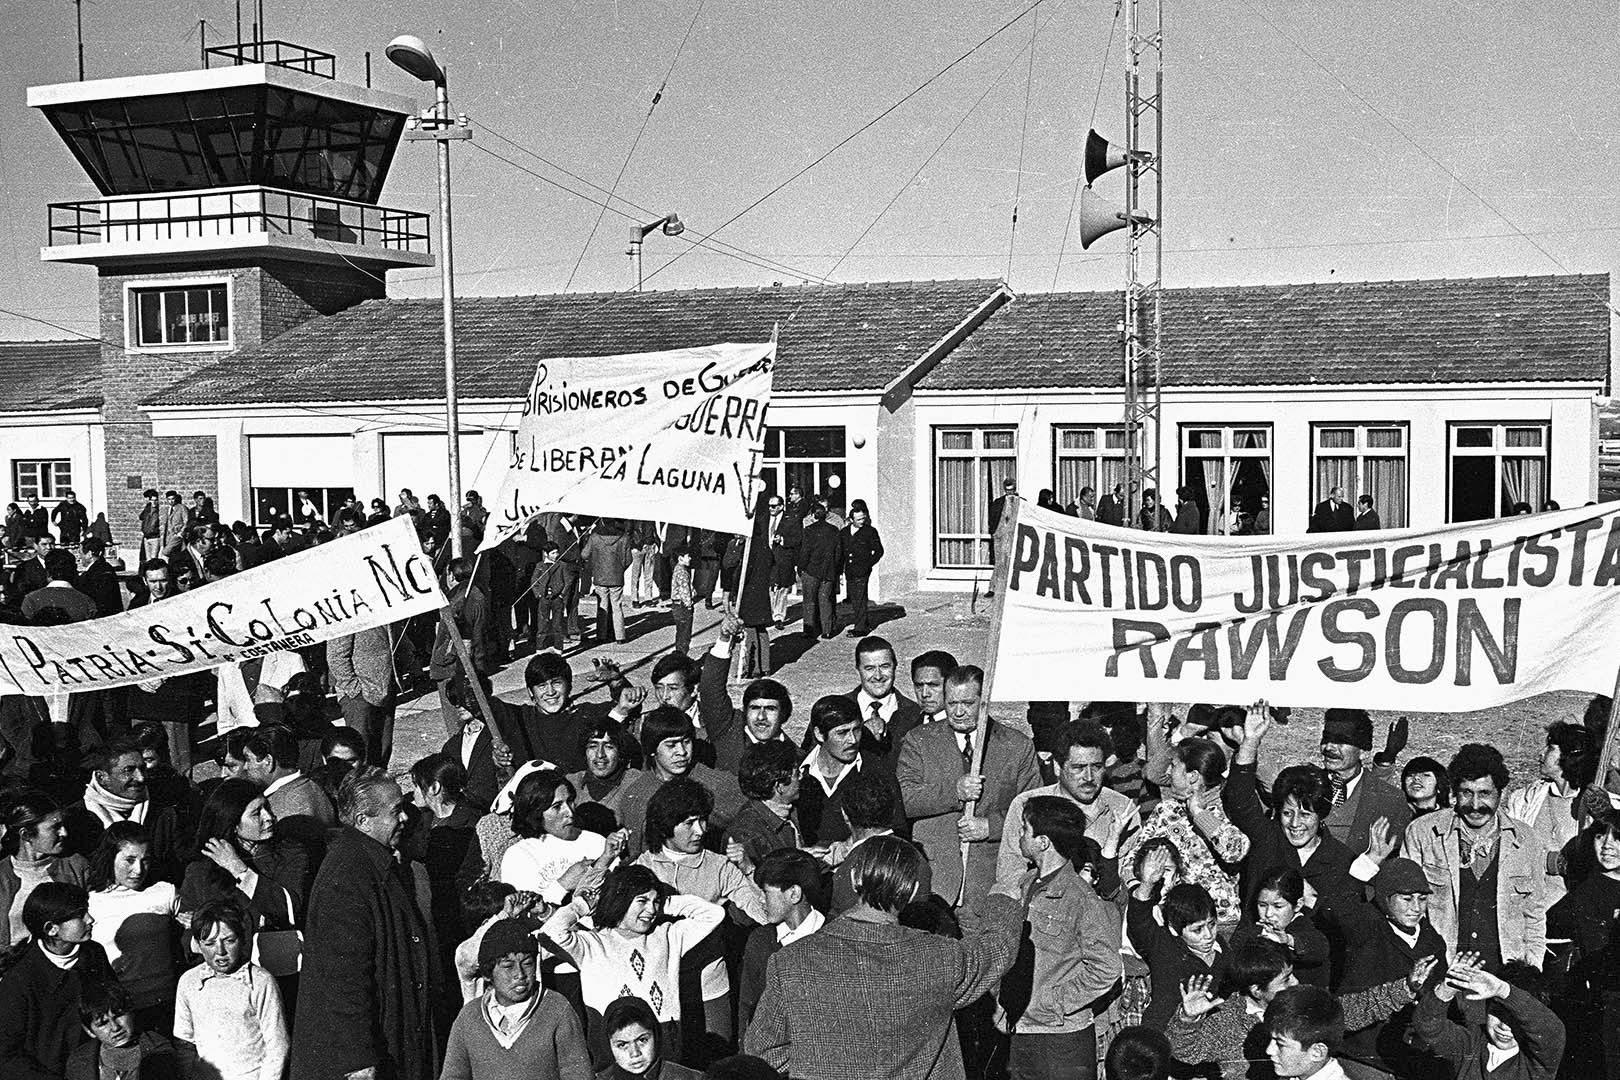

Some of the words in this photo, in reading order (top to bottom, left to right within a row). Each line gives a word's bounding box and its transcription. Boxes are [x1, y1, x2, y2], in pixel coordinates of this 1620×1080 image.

[1009, 522, 1203, 613] PARTIDO
[1233, 516, 1620, 614] JUSTICIALISTA
[1104, 597, 1522, 687] RAWSON
